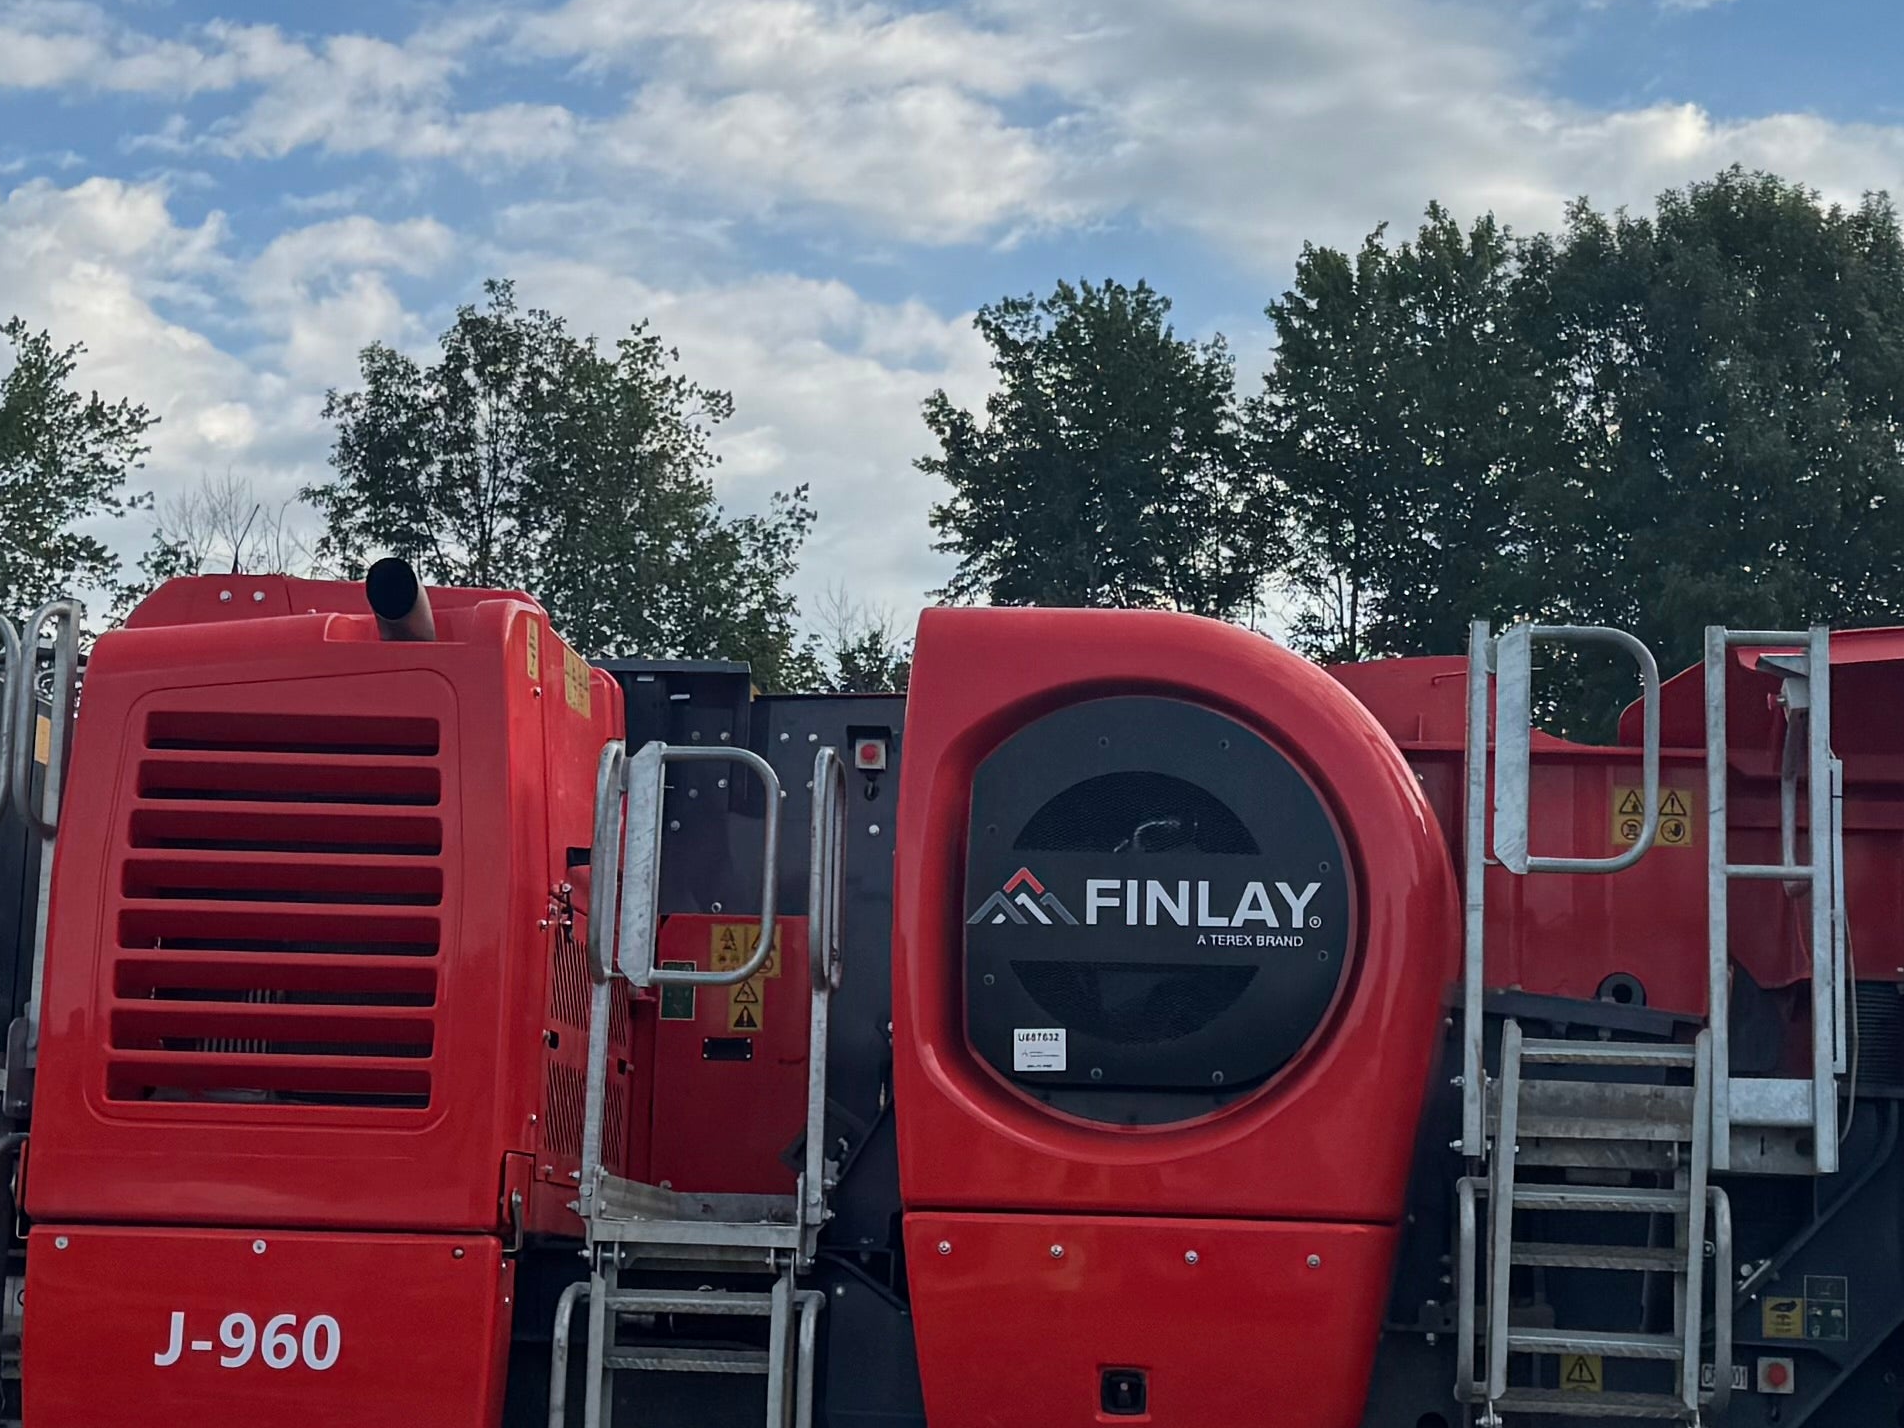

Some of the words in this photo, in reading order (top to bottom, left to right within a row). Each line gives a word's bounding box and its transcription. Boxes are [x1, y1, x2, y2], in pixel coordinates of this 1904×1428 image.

[1085, 878, 1322, 929] FINLAY
[1196, 934, 1207, 946] A
[1209, 934, 1253, 947] TEREX
[1256, 935, 1304, 948] BRAND
[154, 1311, 341, 1371] J-960
